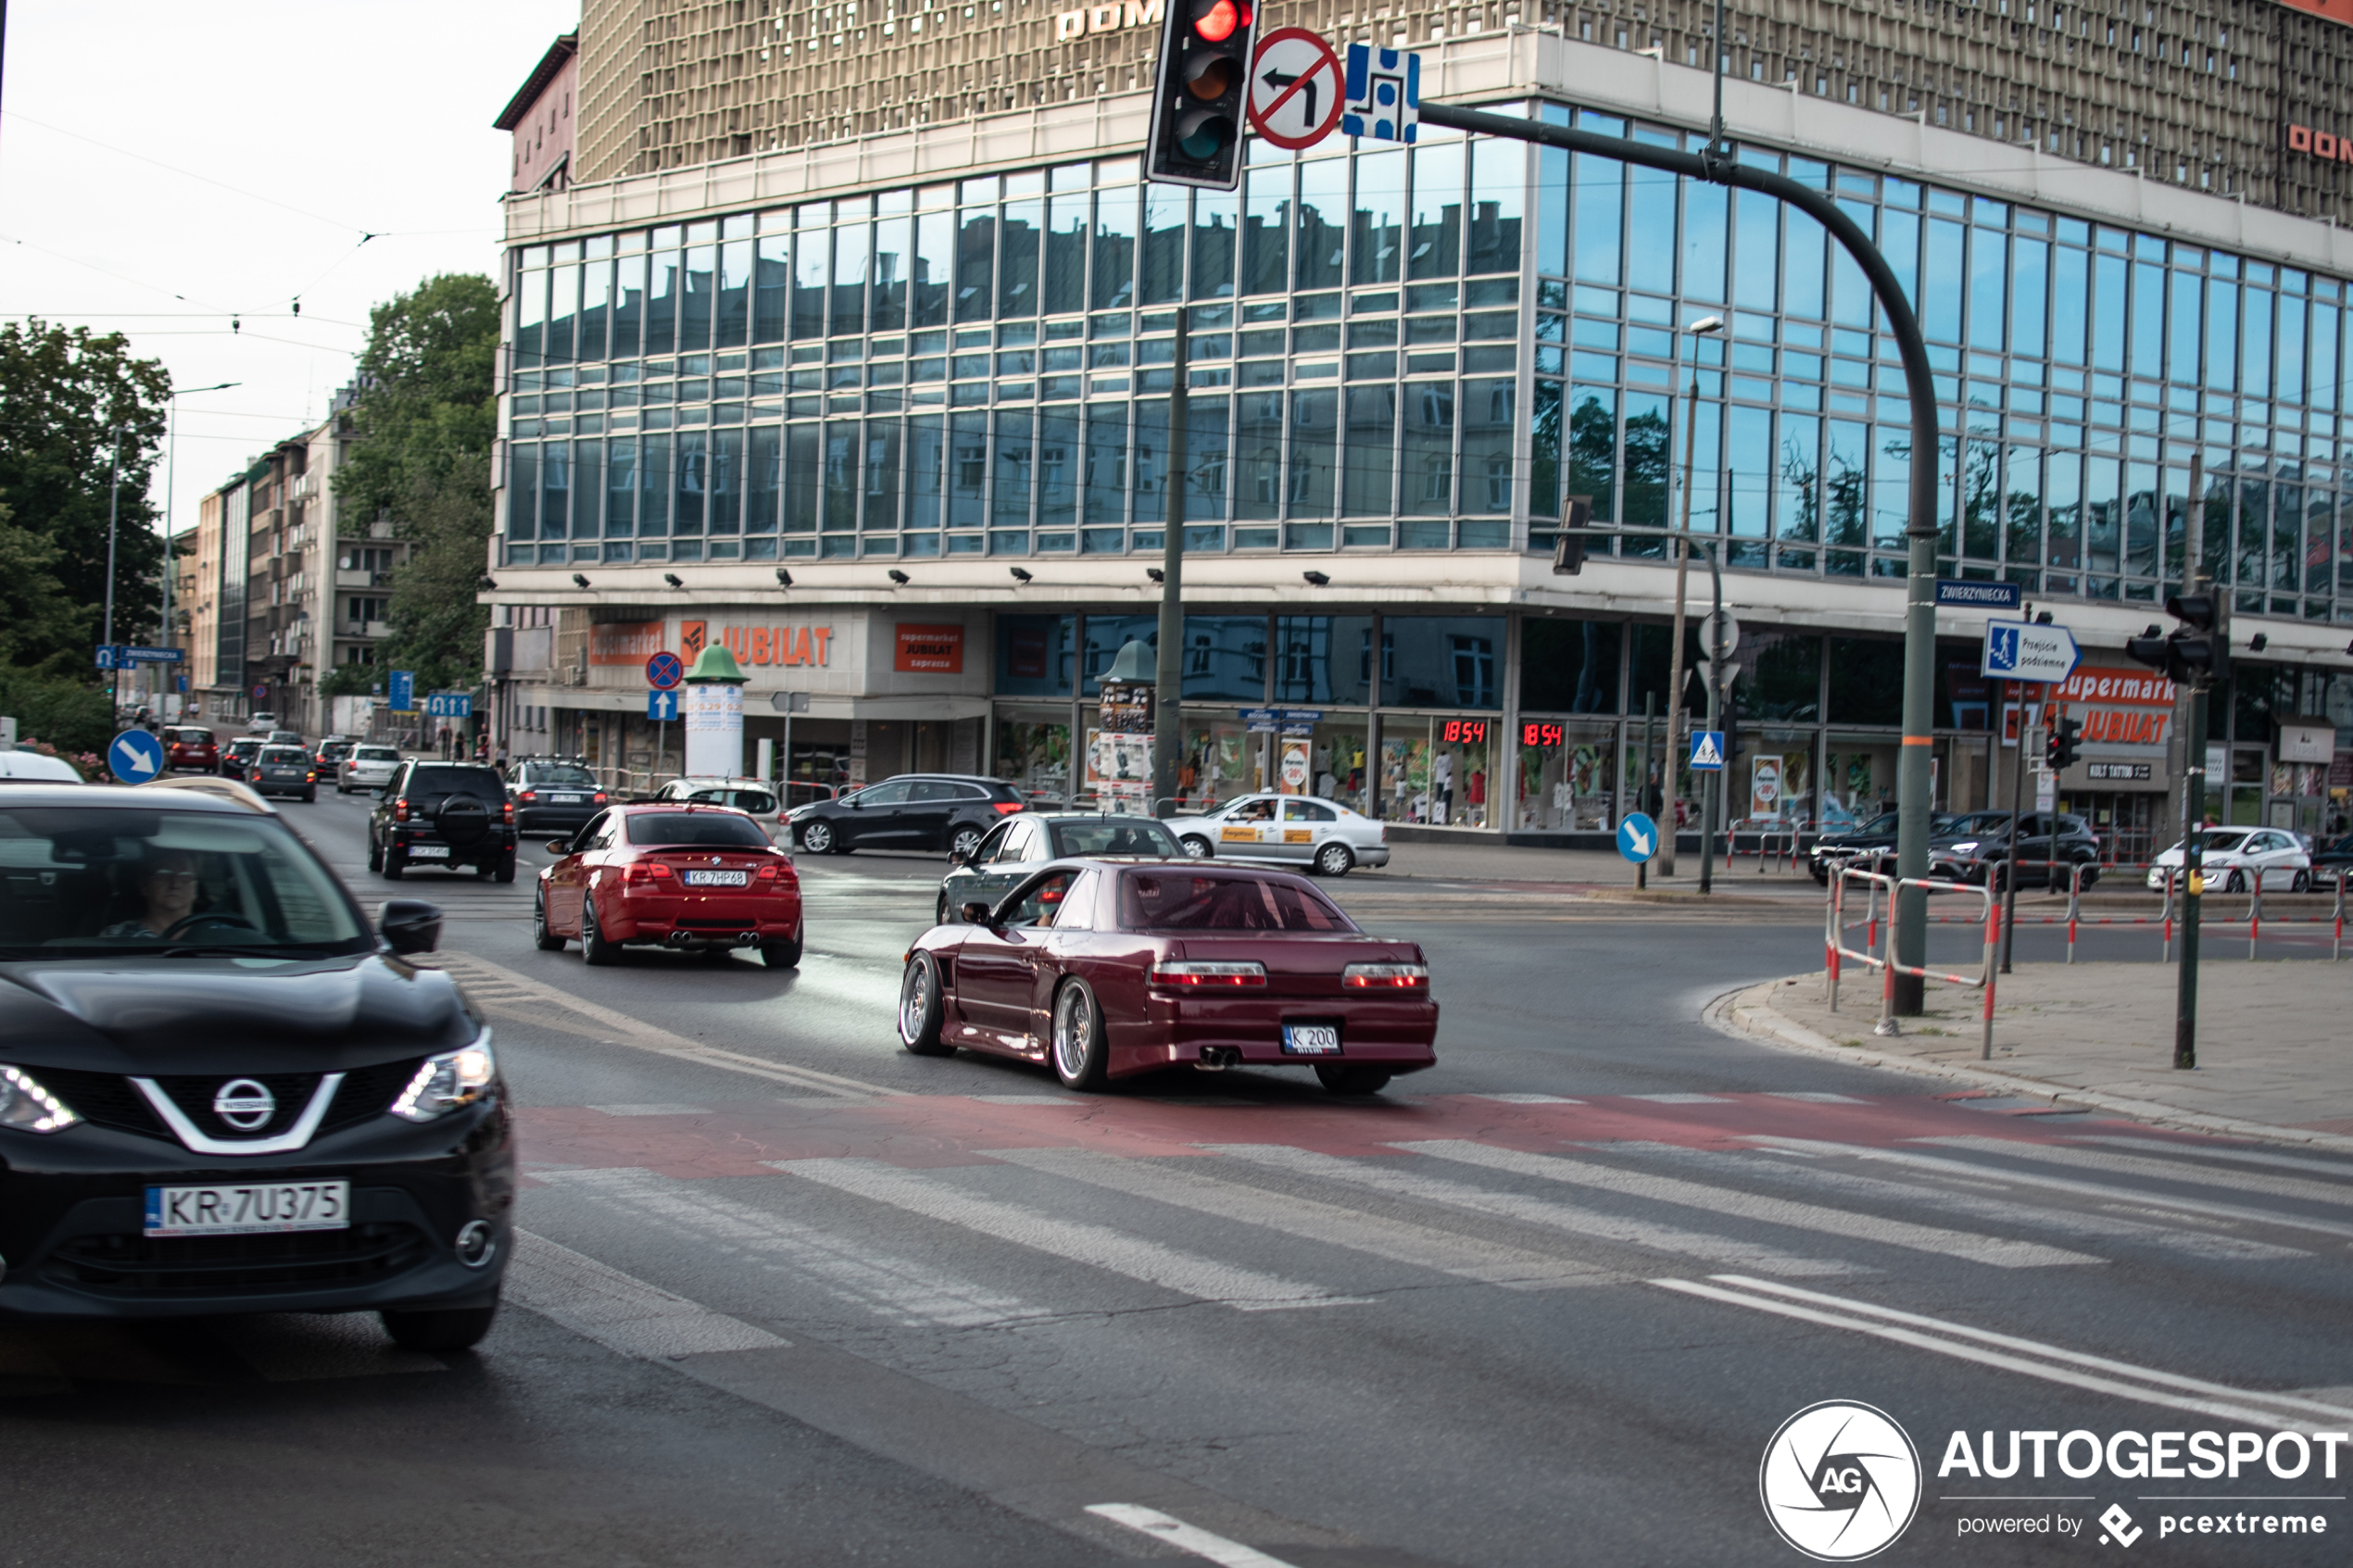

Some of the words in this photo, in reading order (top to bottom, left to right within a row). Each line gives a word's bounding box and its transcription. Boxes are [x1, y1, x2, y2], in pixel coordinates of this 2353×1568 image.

[1941, 585, 2011, 602] ZWIERZYNIECKA
[593, 626, 661, 661] supermarket
[905, 644, 952, 656] JUBILAT
[2022, 637, 2057, 653] Przejście
[2020, 655, 2066, 670] podziemne
[2079, 709, 2168, 744] JUBILAT
[692, 872, 706, 884] KR
[710, 872, 744, 884] 7HP68
[1291, 1028, 1302, 1046] K
[1307, 1029, 1335, 1046] 200
[168, 1190, 222, 1224] KR
[233, 1185, 341, 1223] 7U375
